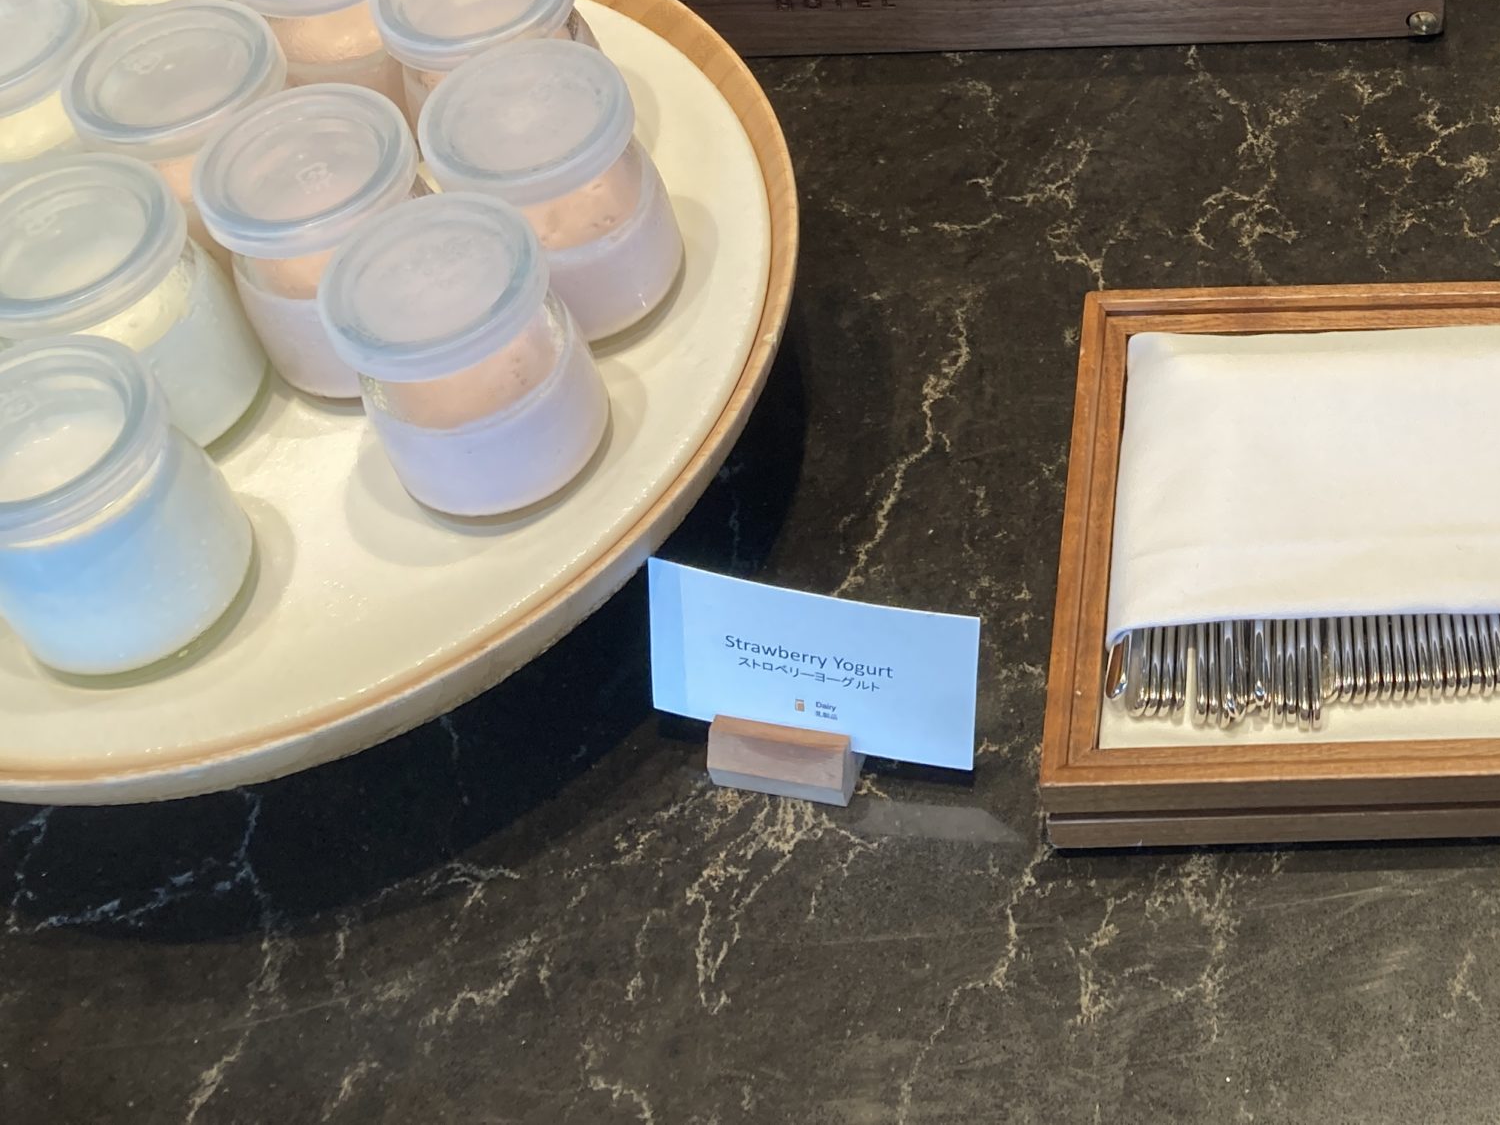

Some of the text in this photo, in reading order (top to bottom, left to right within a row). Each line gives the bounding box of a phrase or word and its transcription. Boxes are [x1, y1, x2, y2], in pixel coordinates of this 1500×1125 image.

[724, 634, 894, 679] Strawberry Yogurt
[738, 657, 880, 692] ストロベリーヨーグルト
[815, 701, 837, 712] Dairy
